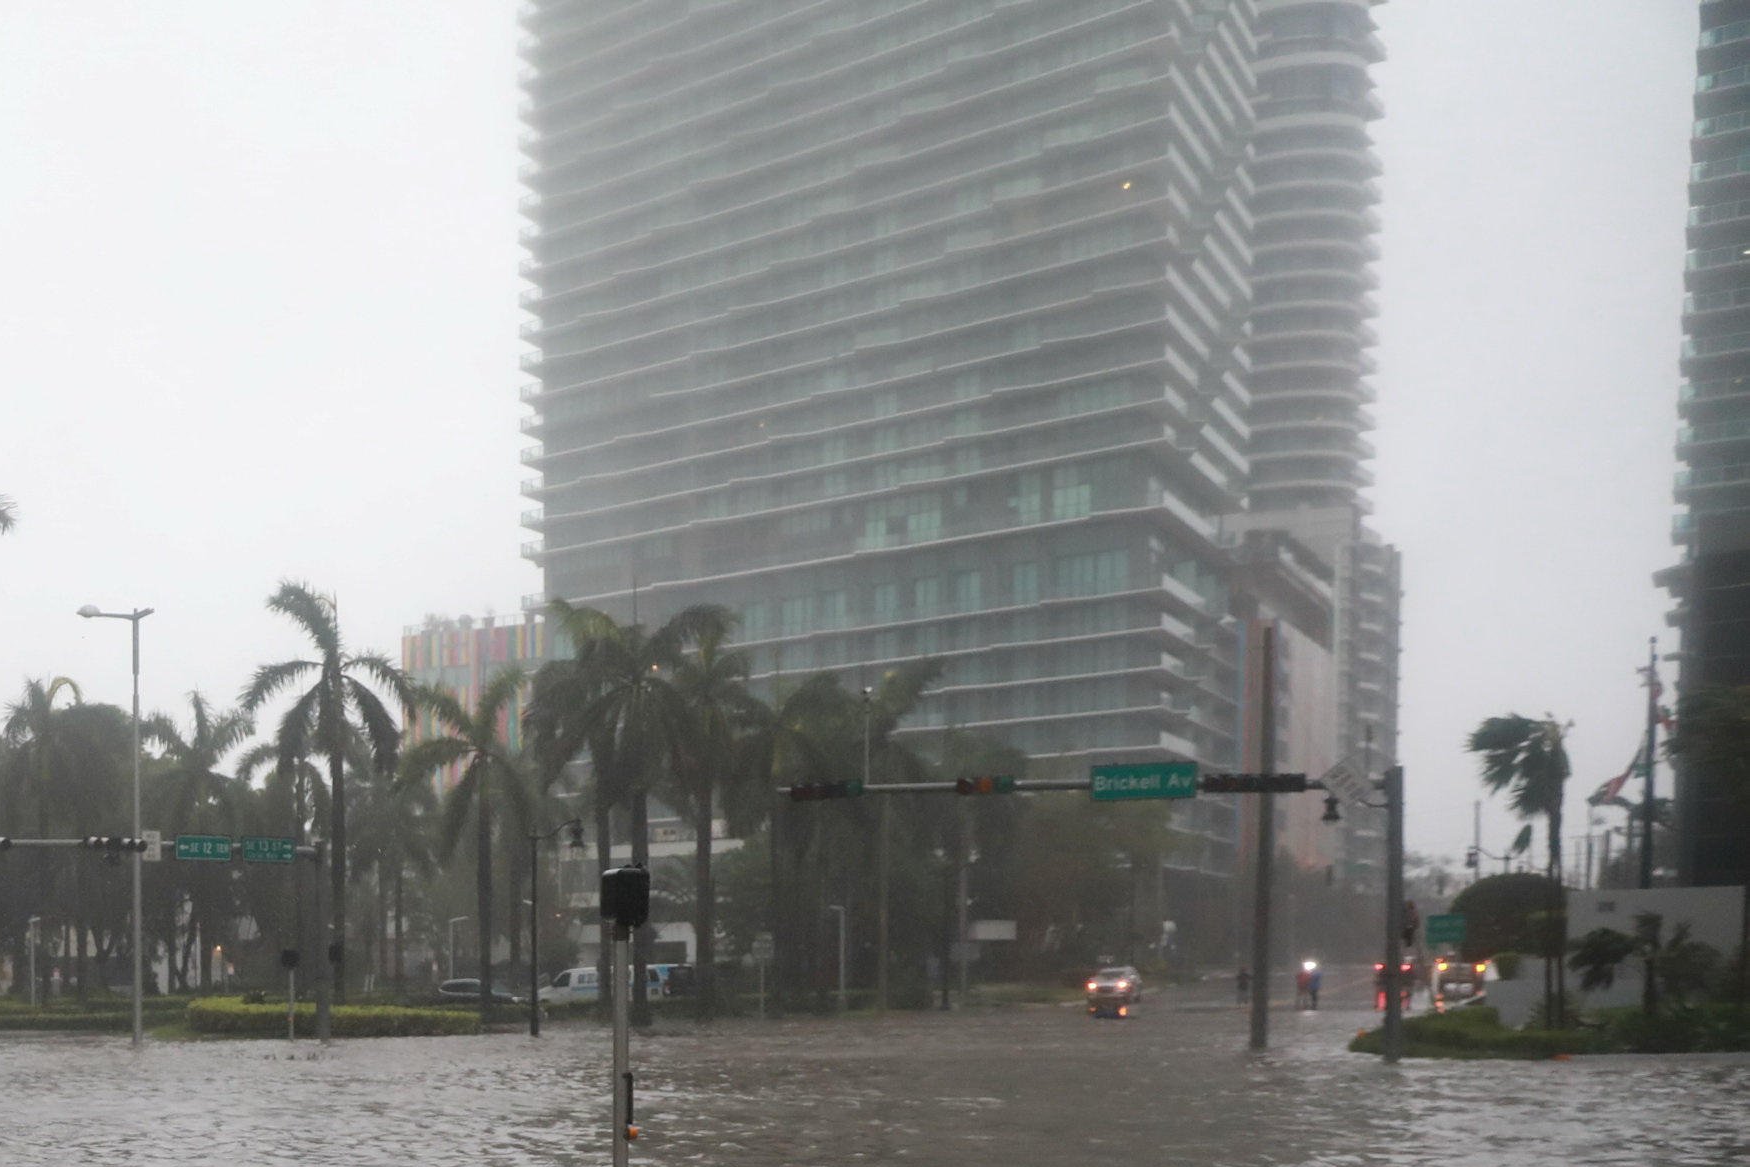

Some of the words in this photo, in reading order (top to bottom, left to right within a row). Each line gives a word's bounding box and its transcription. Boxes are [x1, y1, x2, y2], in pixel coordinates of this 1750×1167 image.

[1094, 775, 1160, 791] Brickell
[1167, 773, 1193, 788] Av
[190, 842, 199, 853] SE
[203, 842, 212, 854] 12
[259, 840, 269, 851] 13
